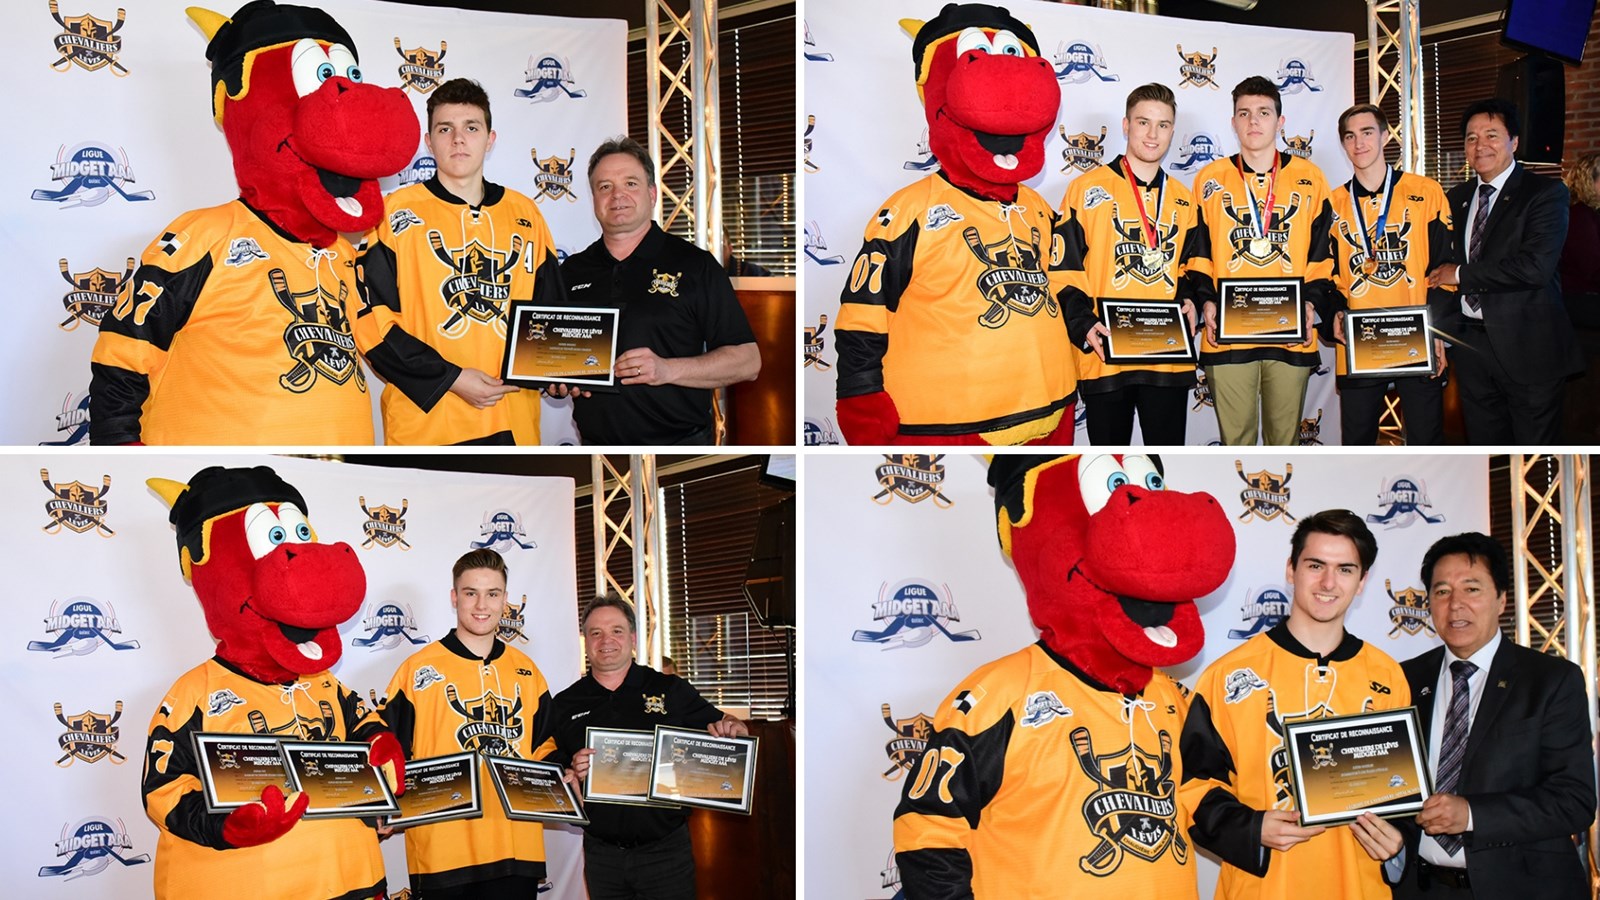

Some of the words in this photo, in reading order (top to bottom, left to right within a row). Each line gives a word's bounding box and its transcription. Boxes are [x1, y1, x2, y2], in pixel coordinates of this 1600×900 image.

[59, 35, 118, 53] CHEVALIERS
[401, 65, 443, 77] CHEVALIERS
[82, 150, 103, 159] LIGUE
[1064, 150, 1102, 160] CHEVALIERS
[51, 160, 107, 181] MIDGET
[107, 162, 135, 182] AAA
[524, 240, 534, 273] A
[850, 251, 887, 293] 07
[985, 271, 1047, 285] CHEVALIERS
[449, 276, 508, 299] CHEVIERS
[67, 293, 118, 305] CHEVALIE
[294, 326, 354, 349] CHEVALIERS
[880, 466, 942, 483] CHEVALIERS
[1243, 489, 1289, 502] CHEVALIERS
[50, 501, 105, 515] CHEVALIERS
[366, 522, 403, 533] CHEVALIERS
[904, 587, 927, 596] LIGUE
[72, 604, 93, 612] LIGUE
[873, 598, 930, 620] MIDGET
[930, 600, 960, 622] AAA
[1391, 607, 1430, 617] CHEVALIERS
[45, 613, 99, 633] MIDGET
[99, 616, 122, 634] AAA
[364, 616, 400, 631] MIDGET
[1369, 680, 1391, 695] SP
[62, 733, 116, 744] CHEVALIERS
[1311, 732, 1339, 742] CERTIFICAT
[1340, 731, 1348, 739] DE
[1349, 725, 1393, 738] RECONNAISSANCE
[1341, 744, 1375, 755] CHEVALIERS
[1376, 743, 1383, 751] DE
[1353, 751, 1377, 759] MIDGET
[908, 746, 965, 804] 07
[1094, 793, 1174, 816] CHEVALIERS
[84, 823, 104, 832] LIGUE
[55, 832, 108, 857] MIDGET
[108, 833, 133, 849] AAA
